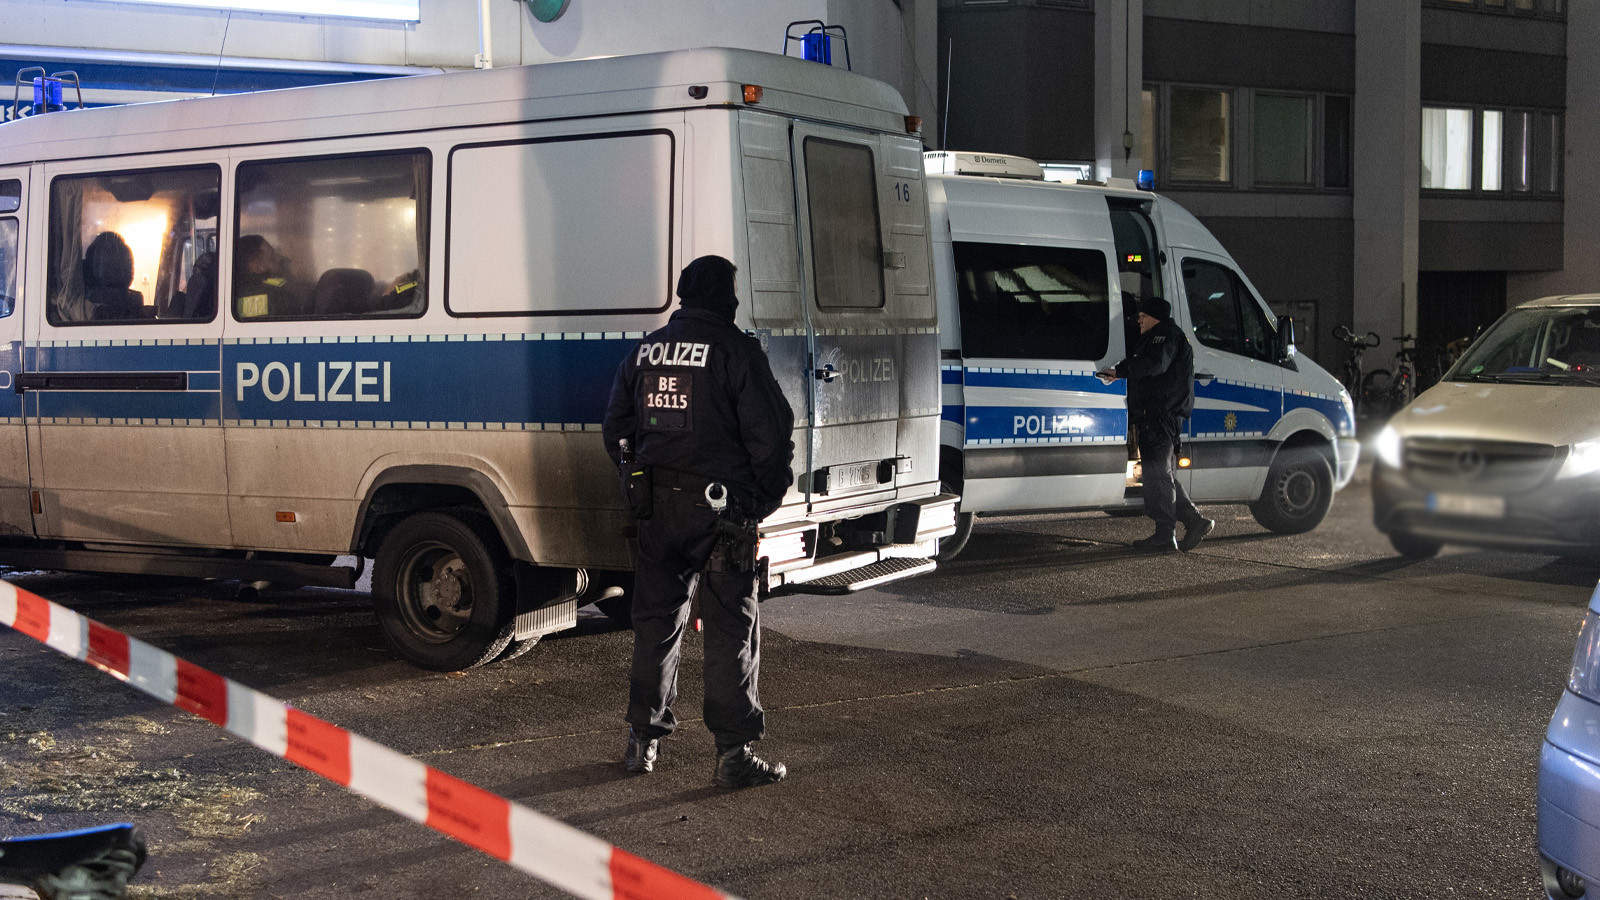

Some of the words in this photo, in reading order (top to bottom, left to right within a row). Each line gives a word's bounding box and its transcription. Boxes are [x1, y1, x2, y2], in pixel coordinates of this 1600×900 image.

[981, 156, 1007, 165] Dometic
[895, 182, 910, 202] 16
[636, 342, 710, 368] POLIZEI
[840, 358, 894, 383] POLIZEI
[236, 361, 391, 402] POLIZEI
[658, 376, 677, 392] BE
[647, 393, 688, 410] 16115
[1013, 414, 1086, 435] POLIZEI
